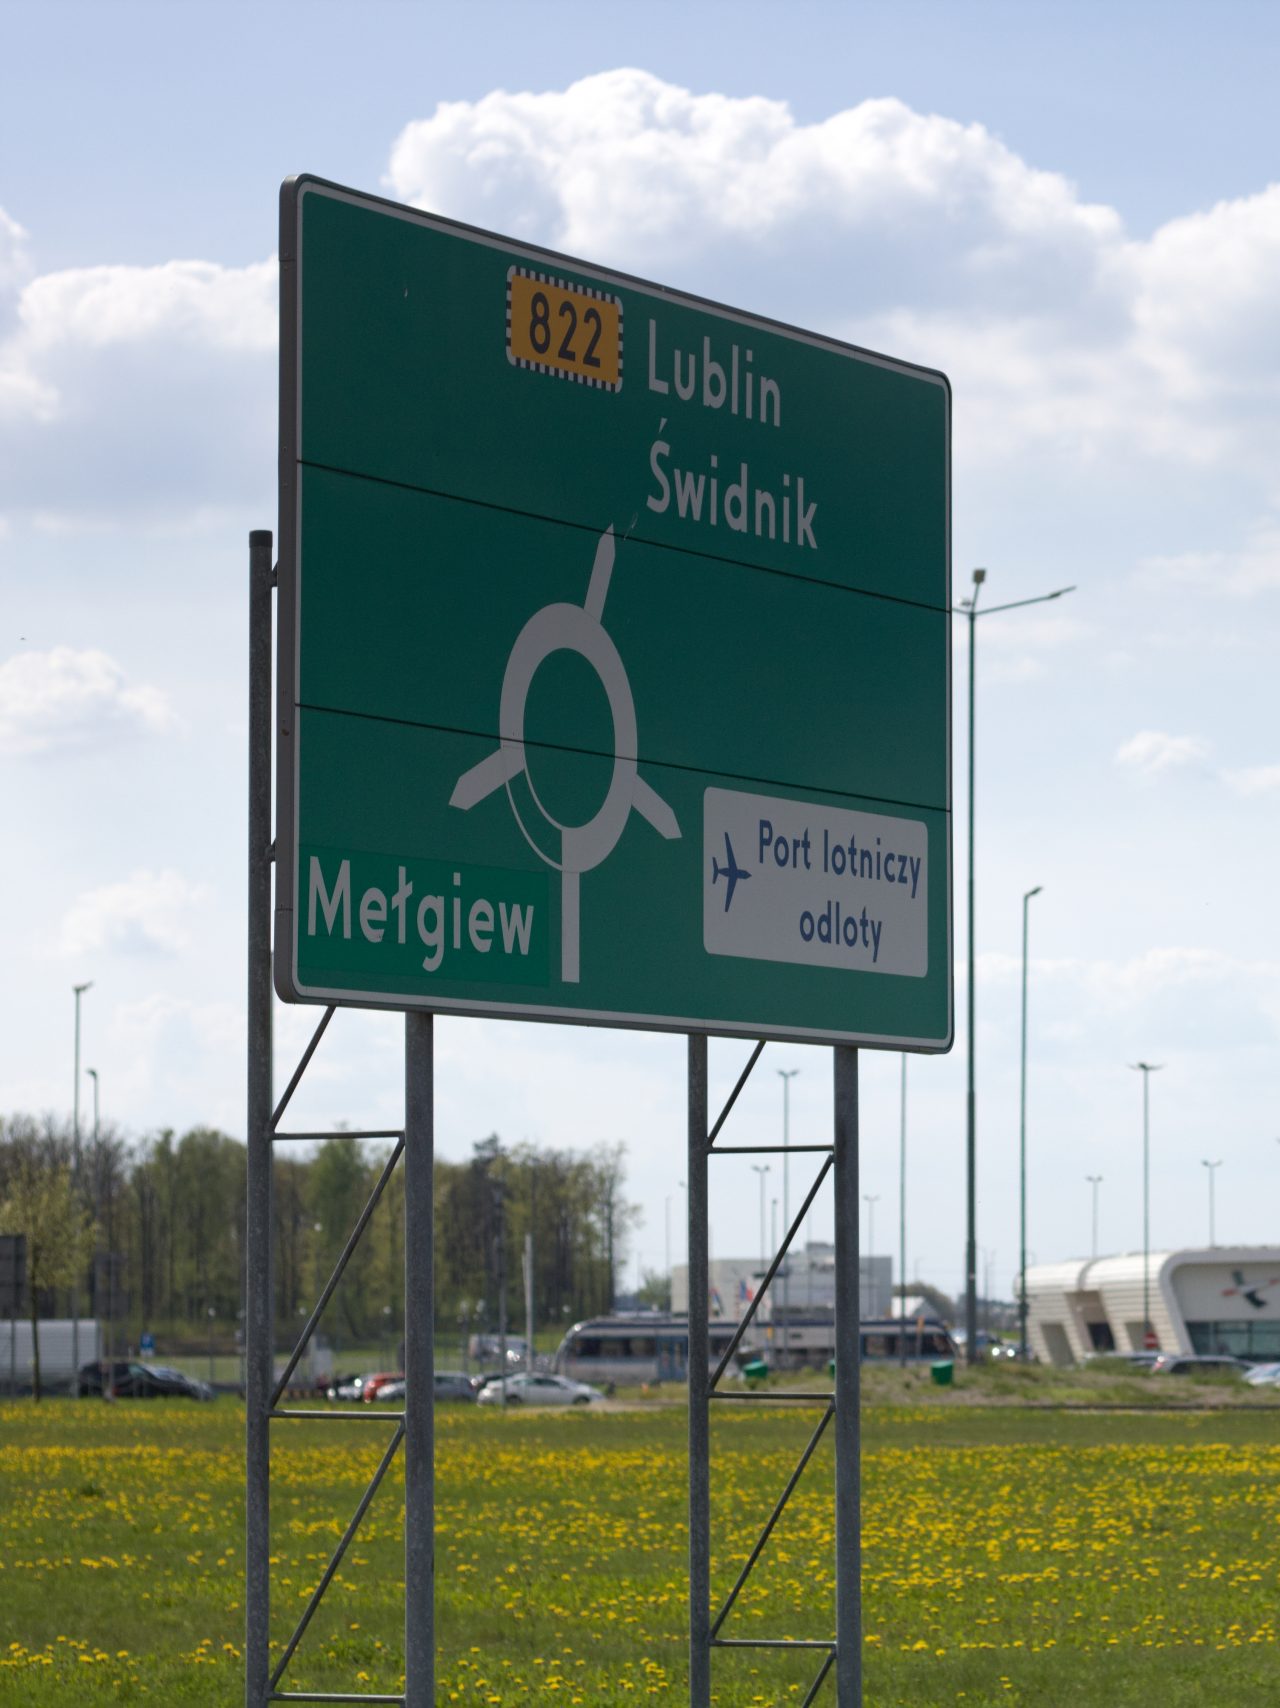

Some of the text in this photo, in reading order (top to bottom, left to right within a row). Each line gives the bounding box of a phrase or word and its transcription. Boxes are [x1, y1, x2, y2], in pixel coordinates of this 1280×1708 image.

[529, 290, 603, 369] 822
[648, 317, 781, 427] Lublin
[646, 417, 818, 549] Świdnik
[759, 819, 922, 899] Port lotniczy
[307, 855, 535, 972] Mełgiew
[799, 900, 884, 964] odloty
